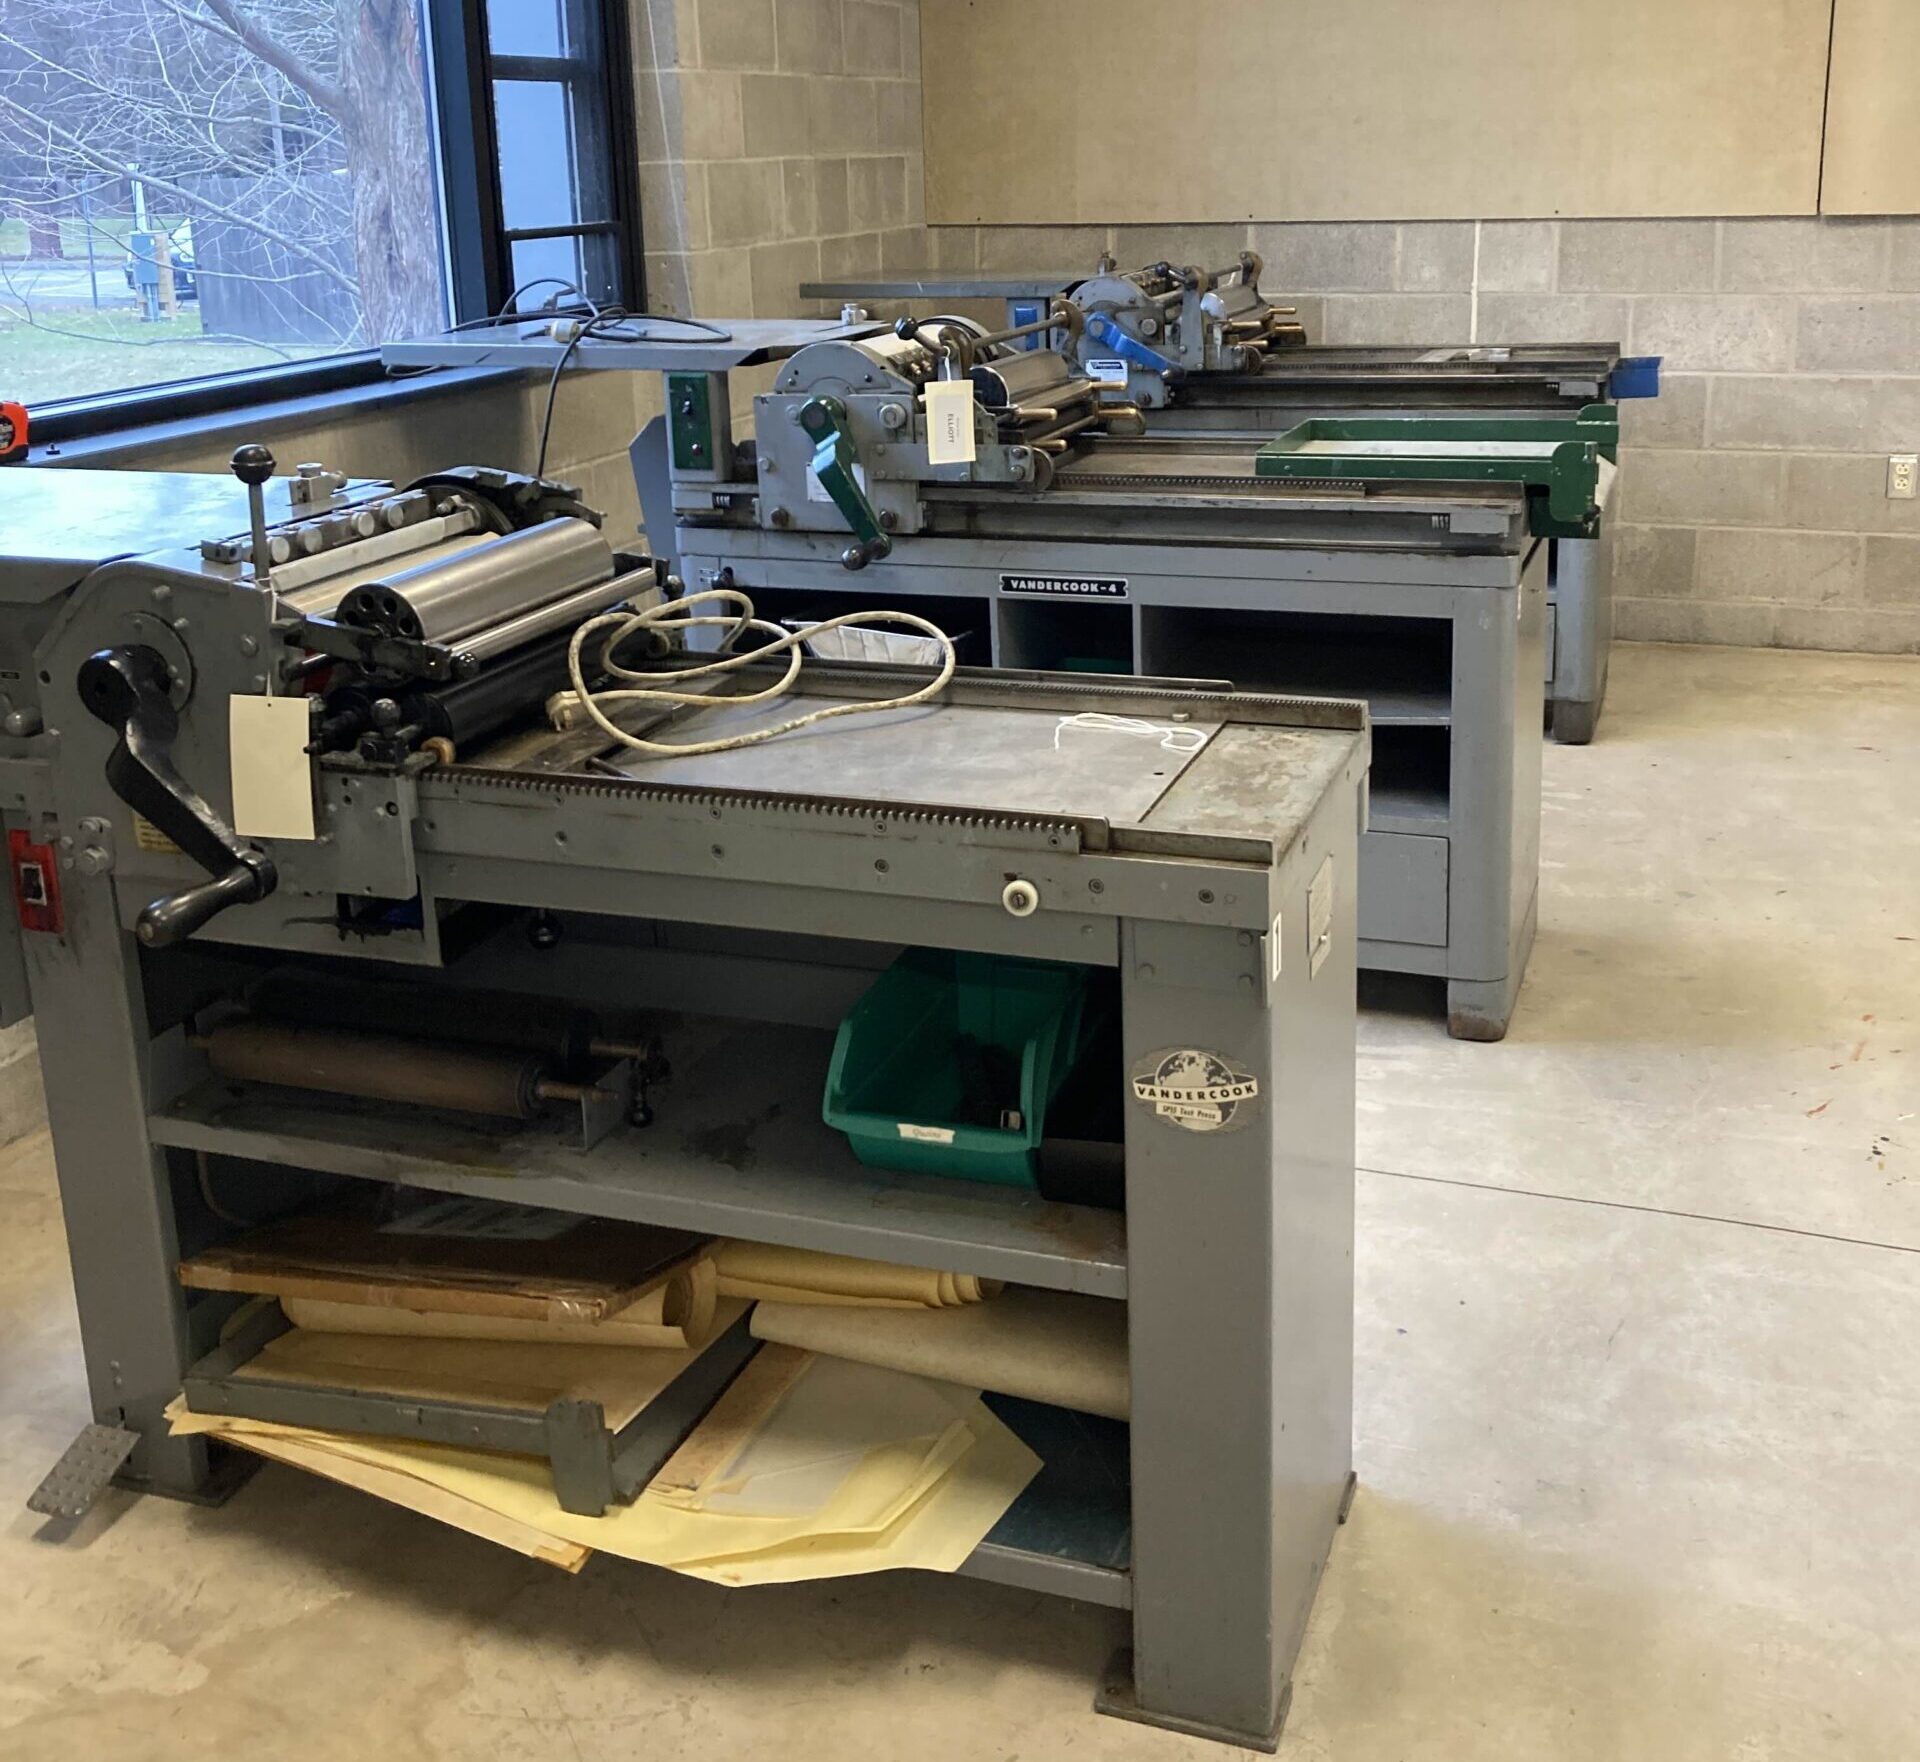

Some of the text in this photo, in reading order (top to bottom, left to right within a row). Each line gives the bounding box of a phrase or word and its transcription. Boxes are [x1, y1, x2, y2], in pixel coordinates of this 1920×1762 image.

[947, 413, 955, 443] ELLIOTT
[1137, 1084, 1255, 1101] VANDERCOOK
[1180, 1107, 1194, 1116] Test
[1197, 1110, 1216, 1119] Press
